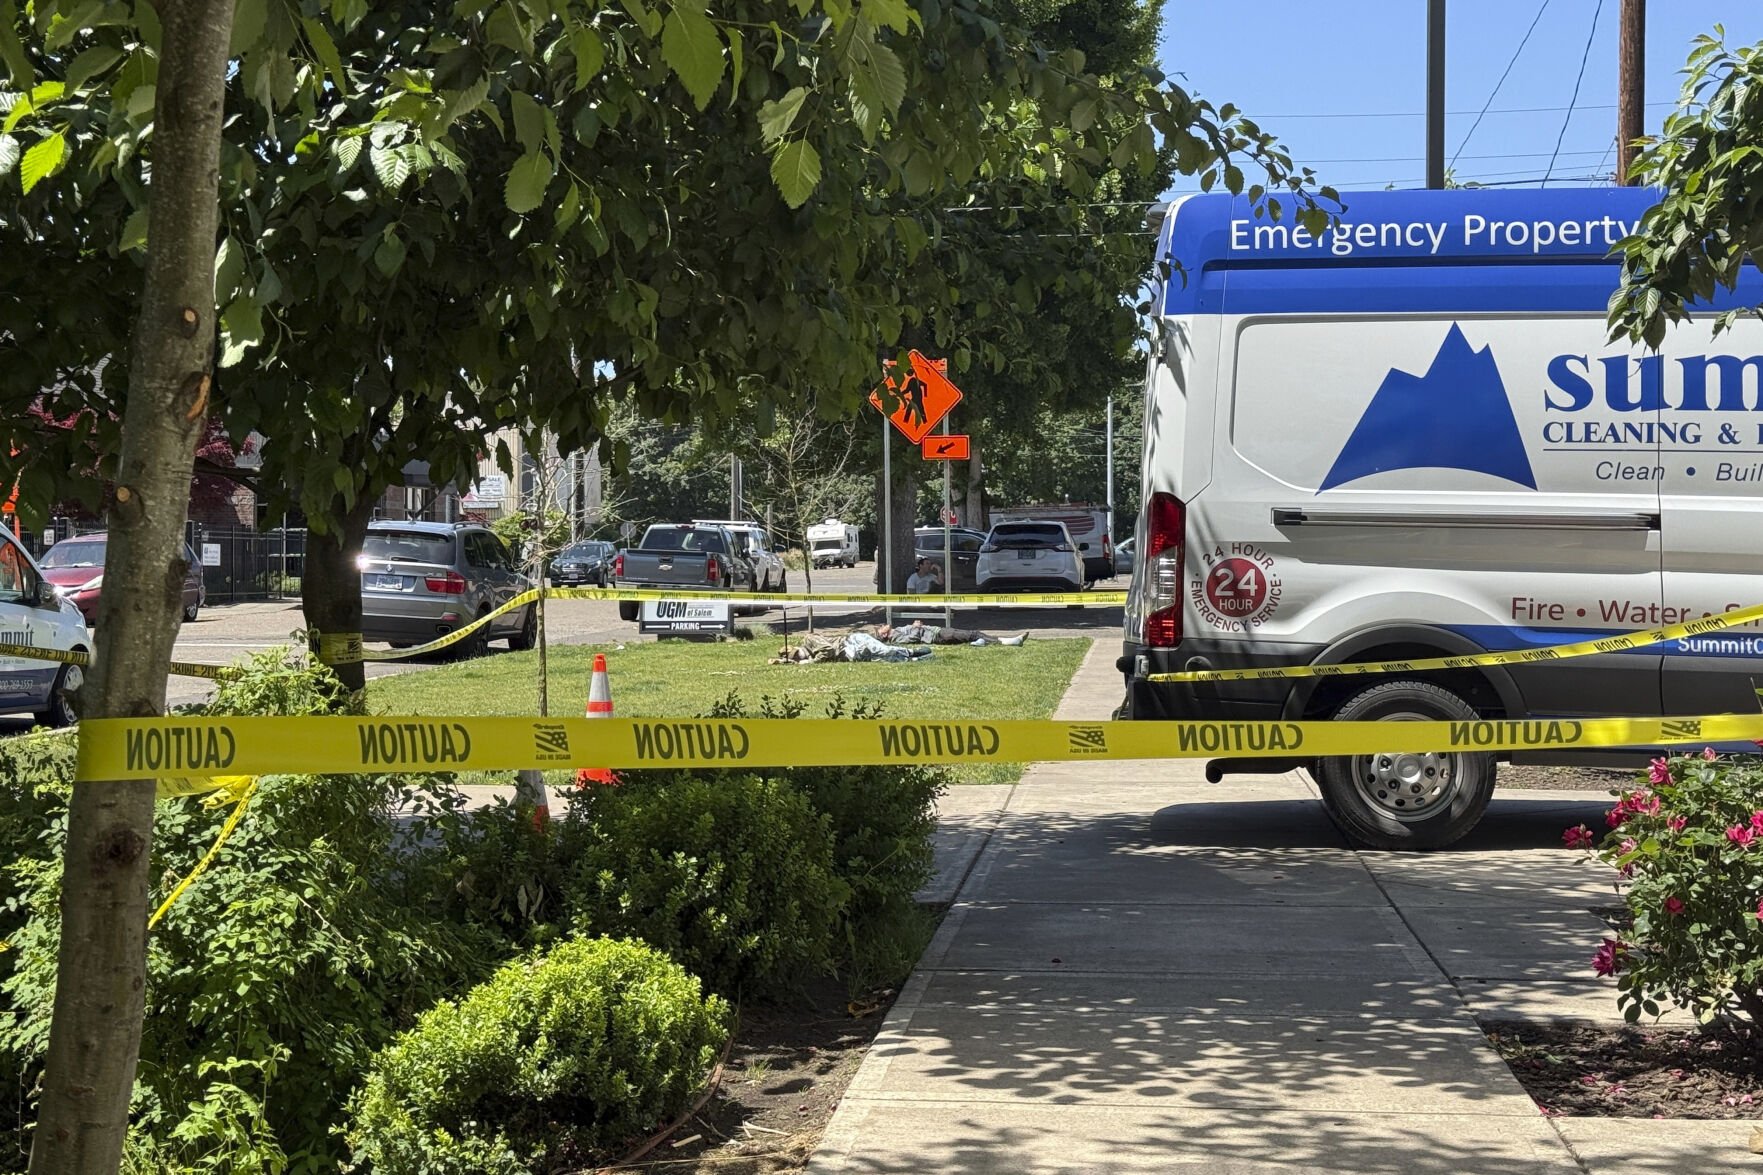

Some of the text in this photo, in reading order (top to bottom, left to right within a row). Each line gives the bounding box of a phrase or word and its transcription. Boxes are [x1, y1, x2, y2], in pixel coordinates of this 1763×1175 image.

[1543, 421, 1702, 444] CLEANING
[1717, 422, 1741, 445] &
[1596, 461, 1665, 481] Clean
[1203, 542, 1274, 570] 24 HOUR
[1214, 568, 1258, 597] 24
[657, 600, 688, 619] UGM
[1191, 579, 1282, 632] EMERGENCY SERVICE
[1219, 599, 1254, 610] HOUR
[1511, 597, 1691, 624] Fire Water
[671, 622, 700, 631] PARKING
[1685, 617, 1728, 635] CAUTION
